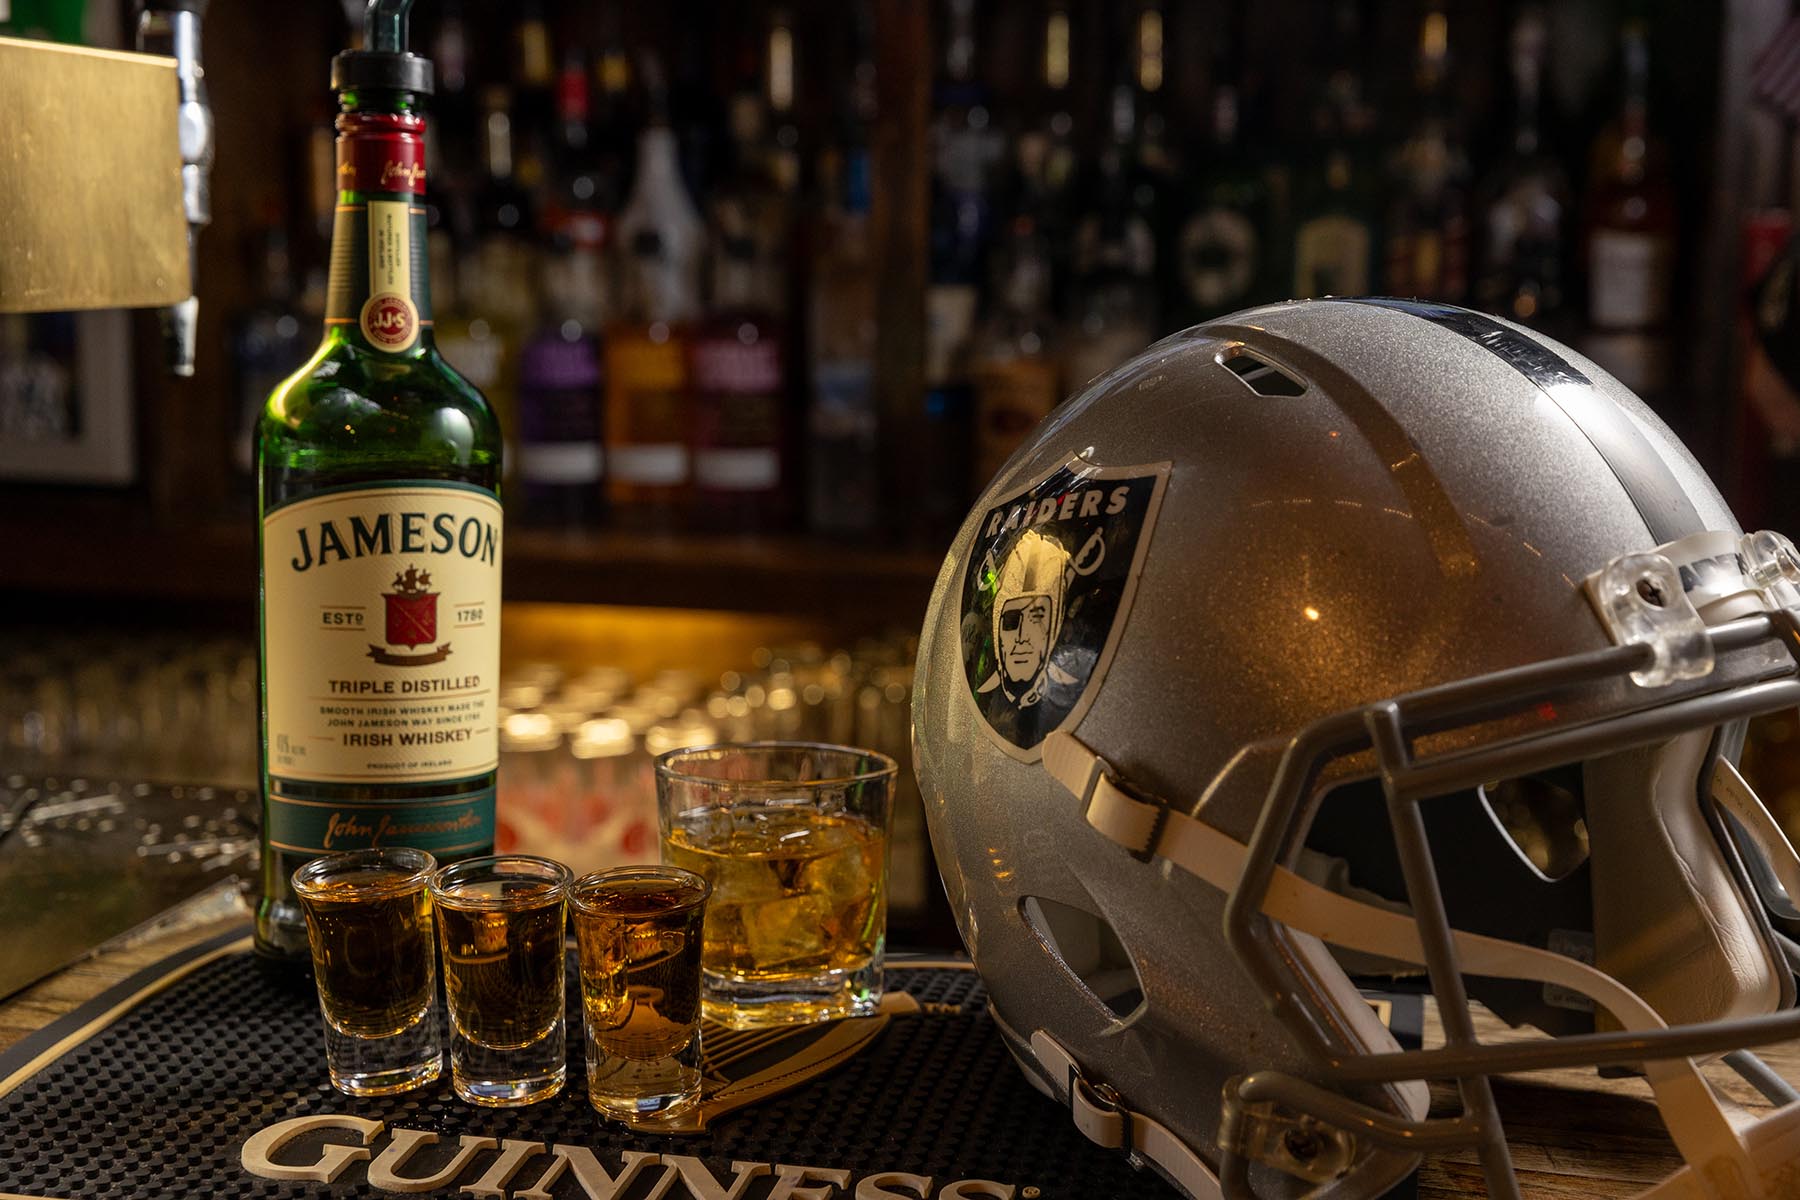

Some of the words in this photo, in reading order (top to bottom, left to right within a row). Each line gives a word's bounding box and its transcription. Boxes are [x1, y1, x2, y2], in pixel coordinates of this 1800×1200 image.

[985, 486, 1131, 539] RAIDERS
[291, 512, 498, 573] JAMESON
[329, 680, 395, 694] TRIPLE
[402, 675, 481, 694] DISTILLED
[320, 706, 364, 716] SMOOTH
[367, 706, 397, 716] IRISH
[400, 705, 445, 716] WHISKEY
[327, 718, 355, 728] JOHN
[358, 719, 408, 729] JAMESON
[412, 718, 433, 728] WAY
[343, 733, 393, 747] IRISH
[399, 728, 473, 747] WHISKEY
